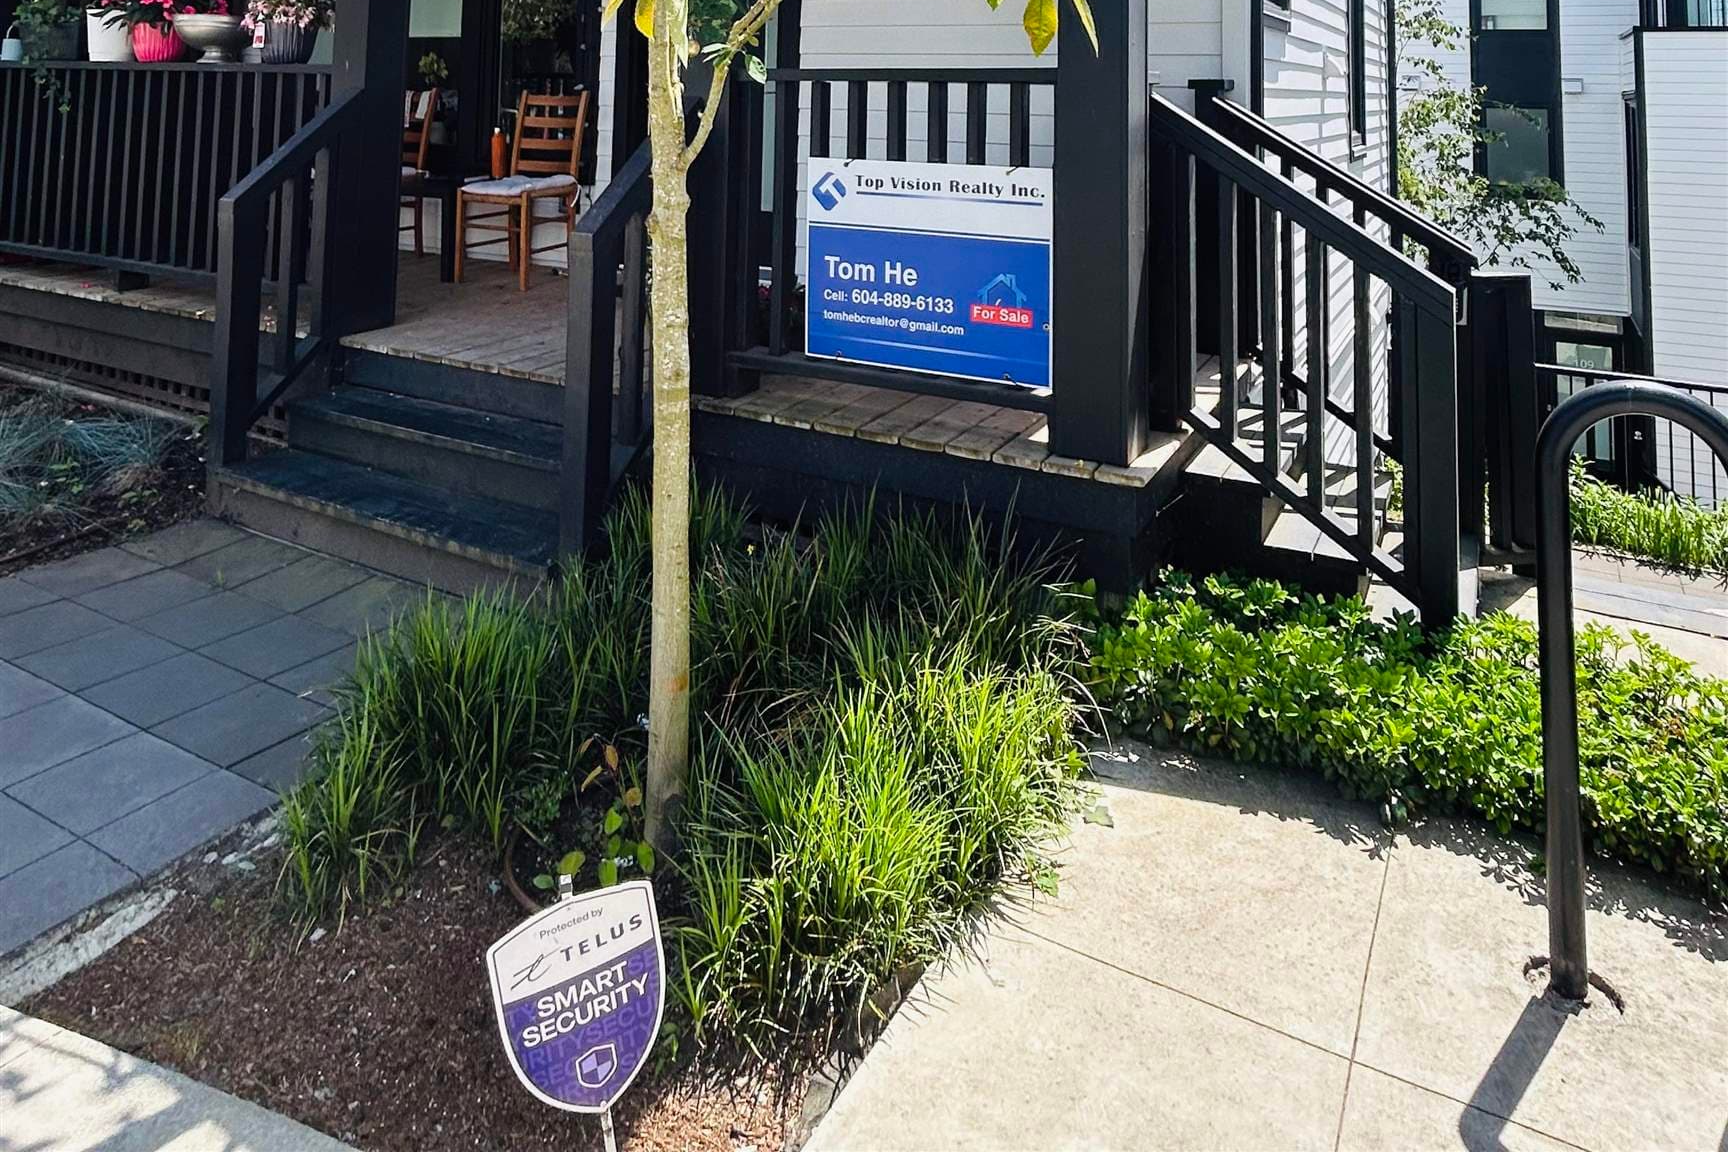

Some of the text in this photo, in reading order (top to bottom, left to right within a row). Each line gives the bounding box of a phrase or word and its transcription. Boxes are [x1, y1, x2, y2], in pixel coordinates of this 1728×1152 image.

[855, 174, 1045, 198] Top Vision Realty Inc.
[825, 256, 918, 286] Tom He
[824, 289, 954, 313] Cell: 604-889-6133
[973, 307, 1029, 324] For Sale
[824, 310, 964, 336] tomhebcrealtor@gmail.com
[539, 907, 604, 939] Protected by
[560, 914, 643, 962] TELUS
[537, 961, 628, 1018] SMART
[523, 974, 649, 1047] SECURITY
